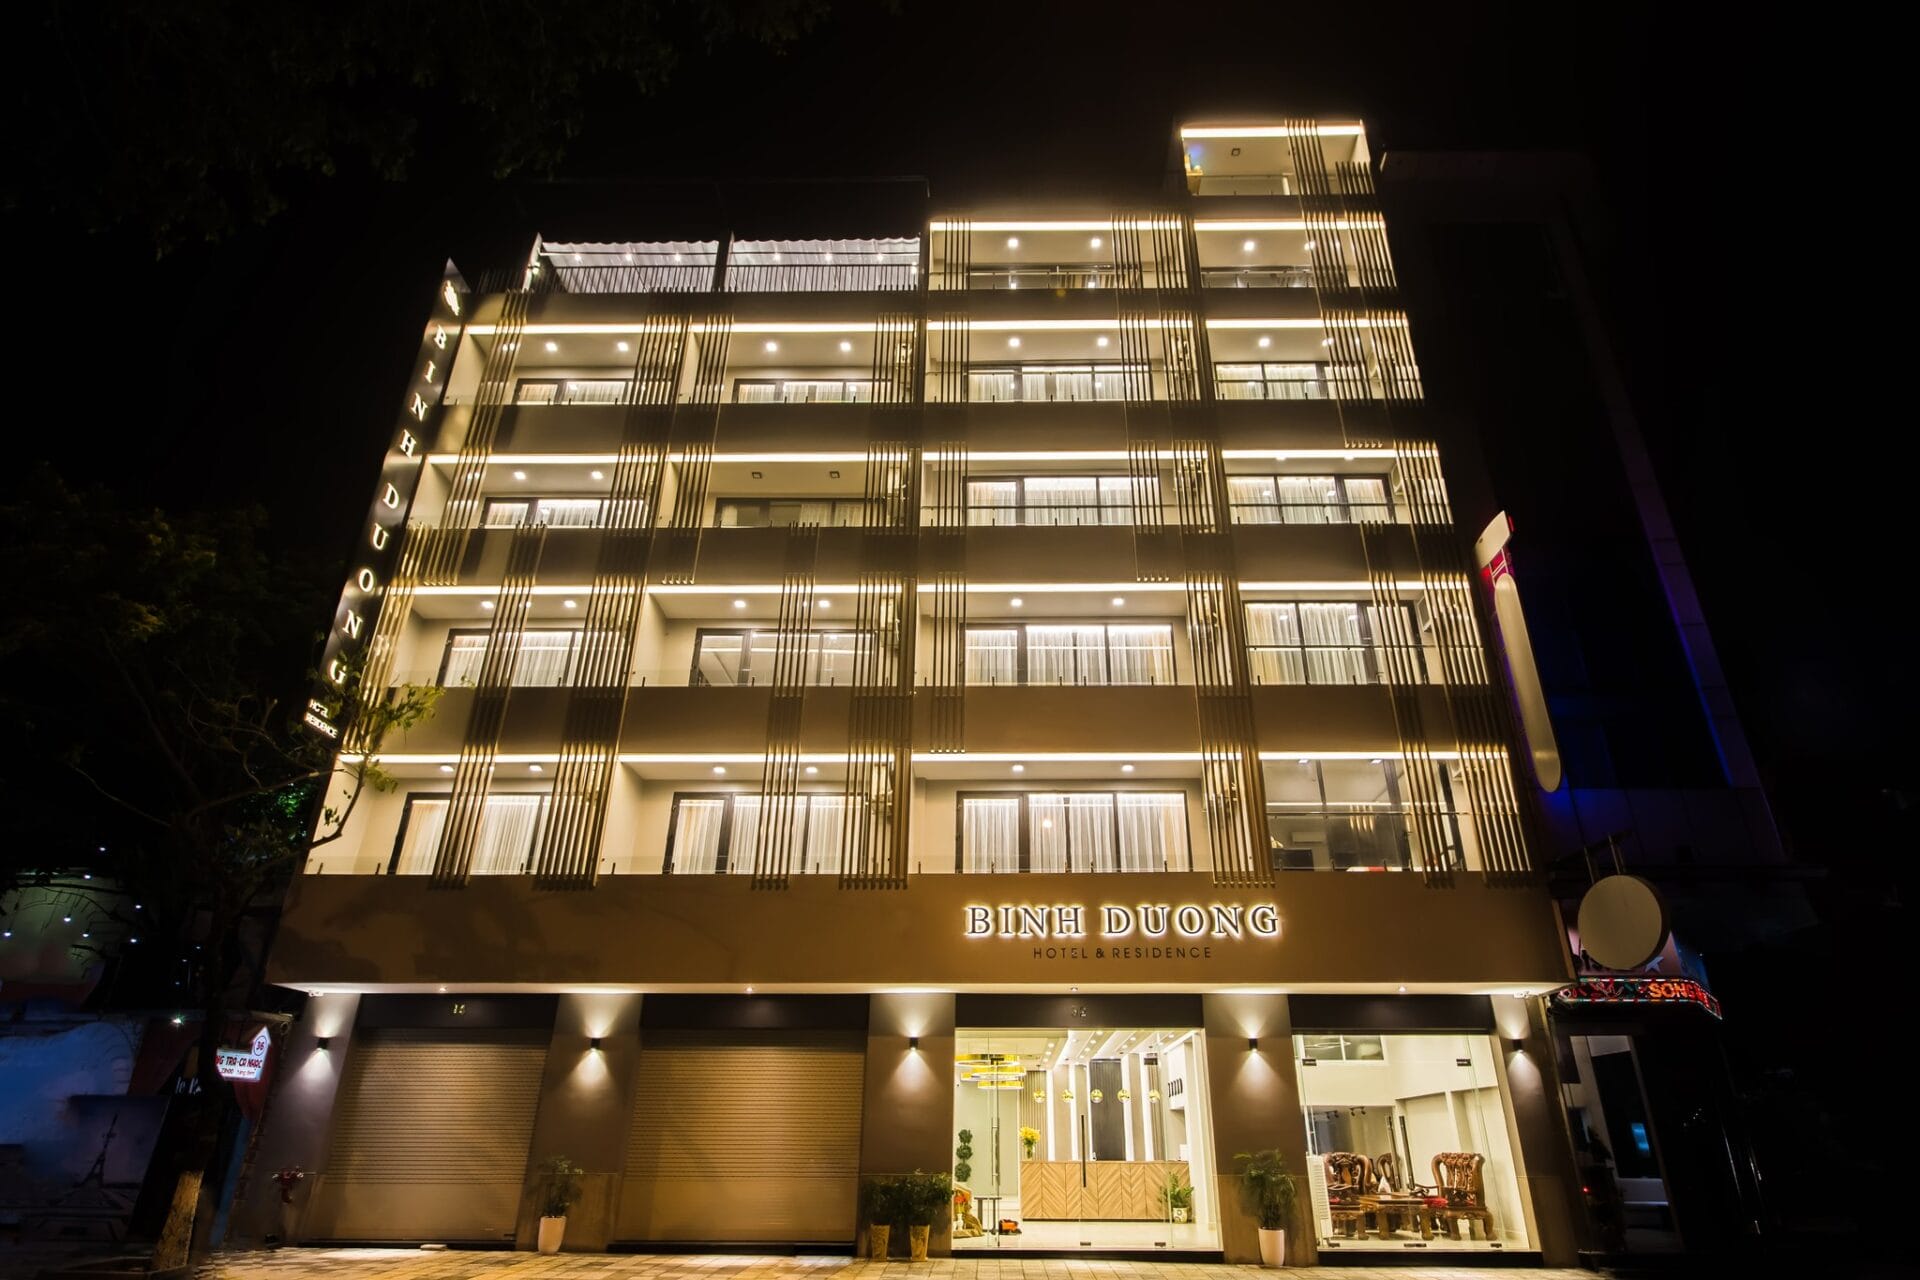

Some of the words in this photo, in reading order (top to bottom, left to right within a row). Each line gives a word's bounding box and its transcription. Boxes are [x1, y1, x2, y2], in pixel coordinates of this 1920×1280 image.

[965, 904, 1084, 937] BINH
[1102, 904, 1280, 937] DUONG
[1033, 946, 1088, 959] HOTEL
[1095, 947, 1105, 959] &
[1112, 946, 1212, 959] RESIDENCE
